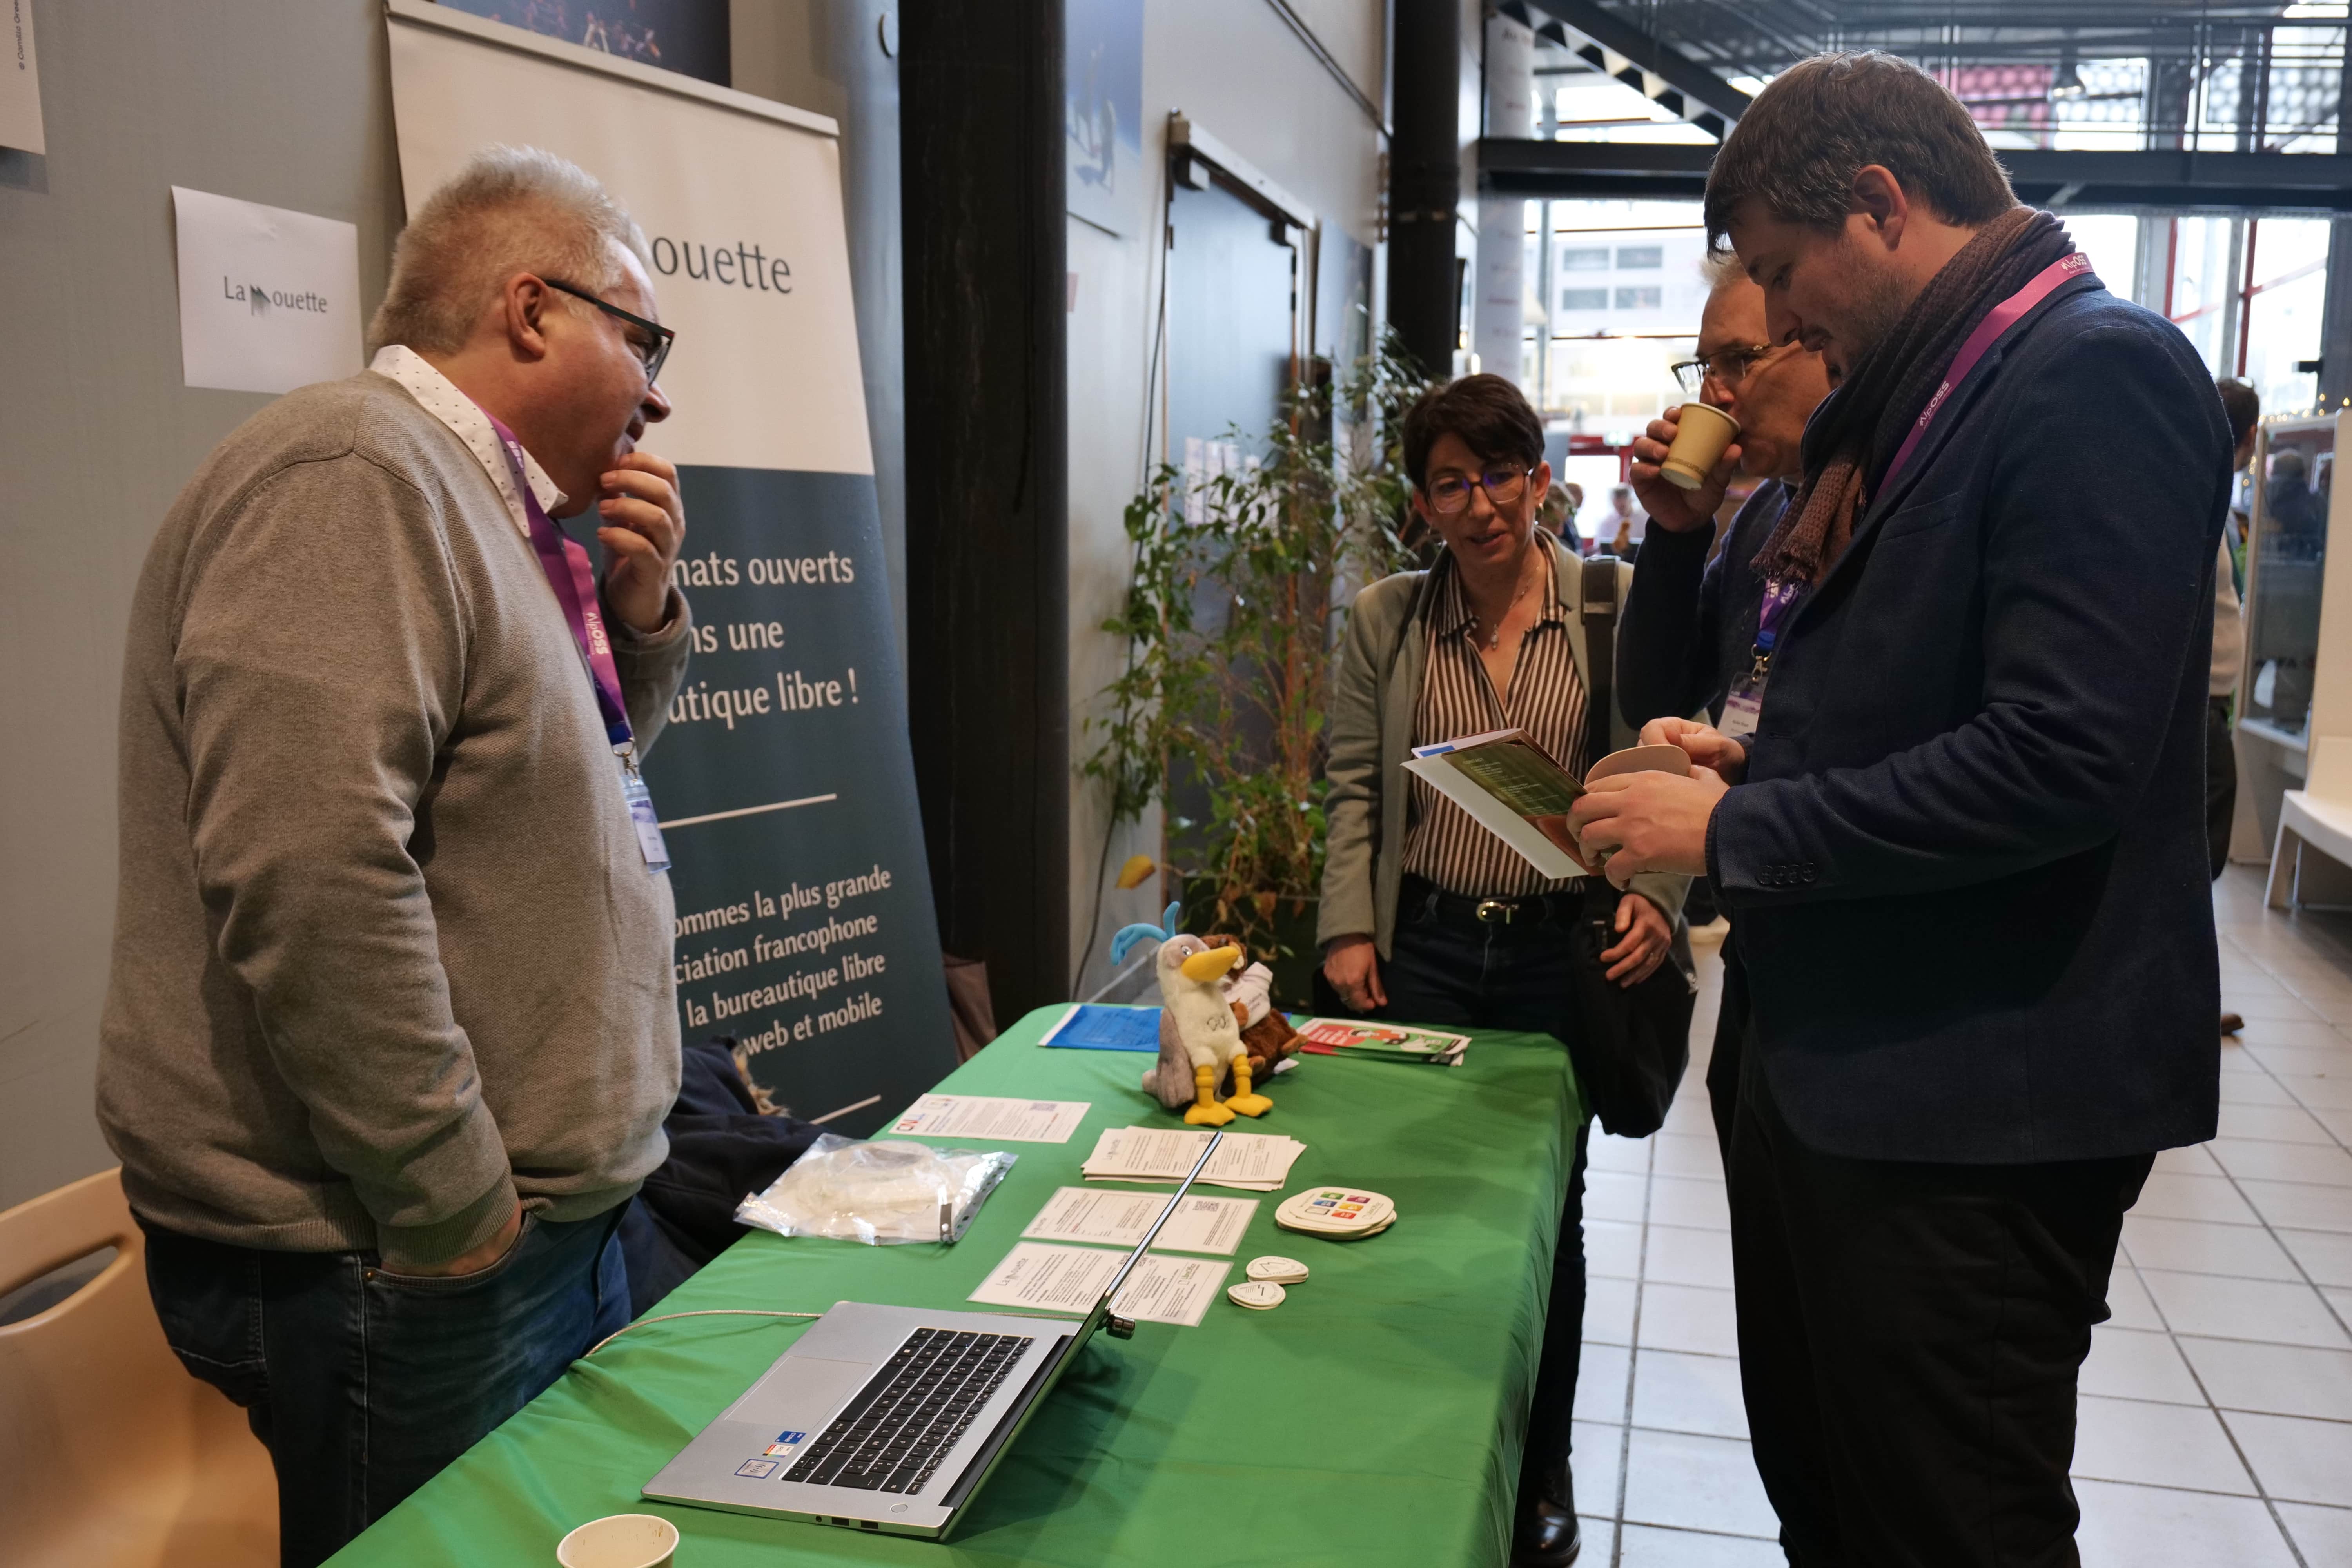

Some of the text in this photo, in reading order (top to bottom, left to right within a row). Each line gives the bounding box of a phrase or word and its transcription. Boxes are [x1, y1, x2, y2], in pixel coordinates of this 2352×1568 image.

[224, 276, 246, 301] La
[653, 237, 792, 294] ouette
[1920, 380, 1949, 426] AlpOSS
[748, 550, 855, 584] ouverts
[728, 621, 784, 651] une
[668, 681, 770, 730] utique
[777, 670, 843, 711] libre
[675, 864, 892, 938] ommes la plus grande
[674, 915, 878, 985] ciation francophone
[686, 952, 886, 1028] la bureautique libre
[742, 991, 883, 1056] web et mobile
